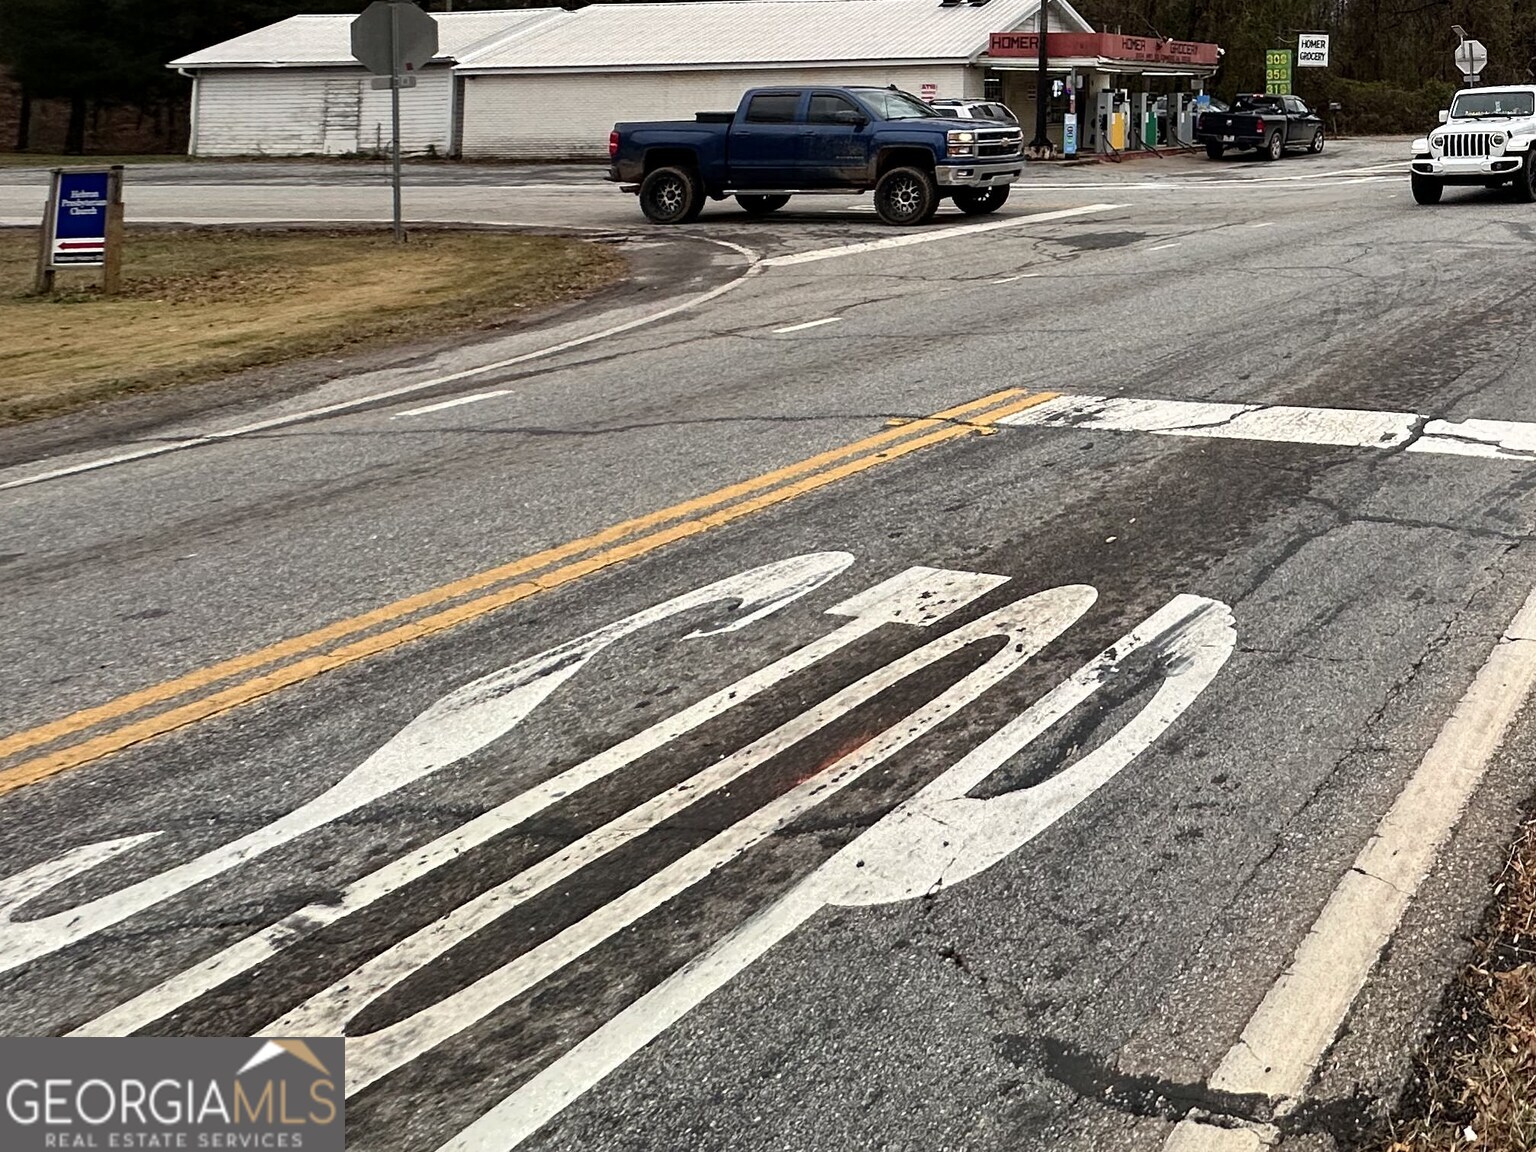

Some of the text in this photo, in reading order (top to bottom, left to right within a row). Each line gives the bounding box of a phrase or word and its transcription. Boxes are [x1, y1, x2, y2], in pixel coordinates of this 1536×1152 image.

[992, 36, 1039, 49] HOMER
[1121, 37, 1198, 56] HOMER GROCERY
[1301, 39, 1326, 49] HOMER
[1299, 51, 1326, 61] GROCERY
